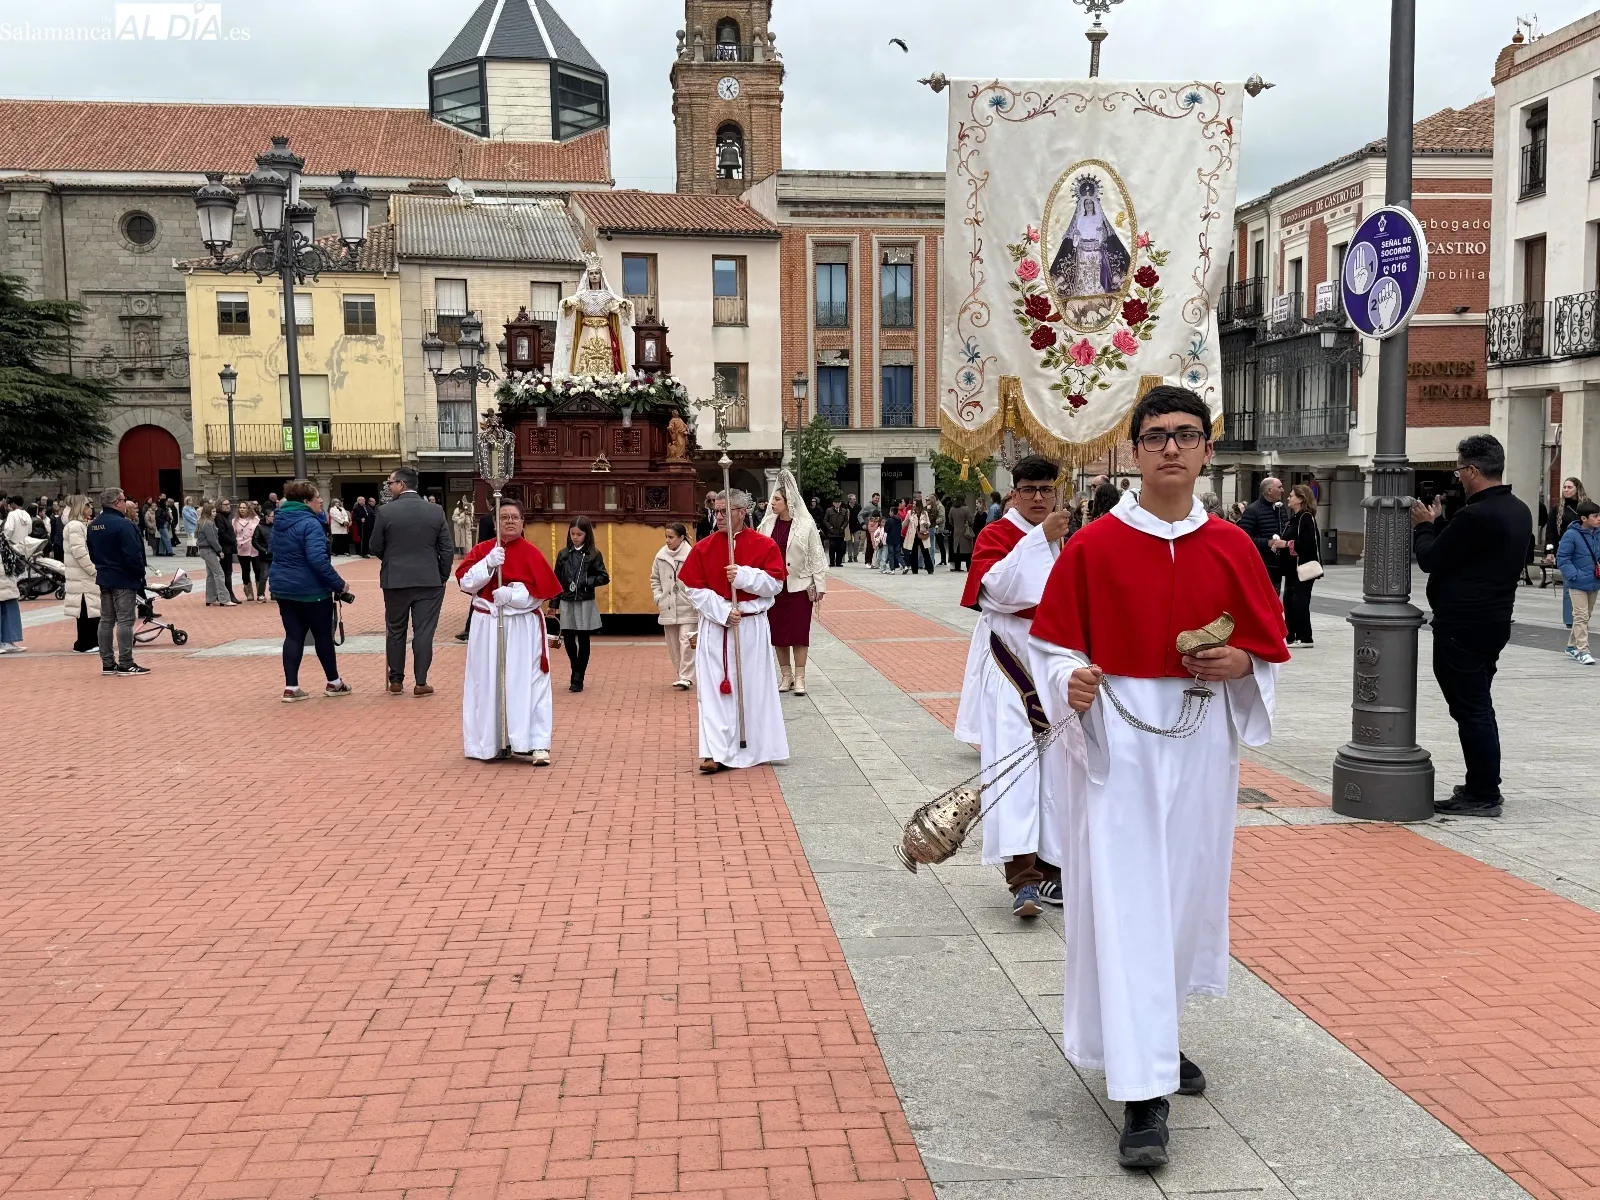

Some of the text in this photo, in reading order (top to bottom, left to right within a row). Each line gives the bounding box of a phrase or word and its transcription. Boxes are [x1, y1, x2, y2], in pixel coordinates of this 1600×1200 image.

[1316, 200, 1324, 213] DE
[1325, 190, 1349, 209] CASTRO
[1350, 184, 1361, 199] GIL
[1381, 236, 1412, 249] SEÑAL DE
[1427, 241, 1487, 255] CASTRO
[1380, 246, 1411, 257] SOCORRO
[1369, 261, 1374, 272] 1
[1391, 262, 1407, 274] 016
[1371, 299, 1378, 311] 2
